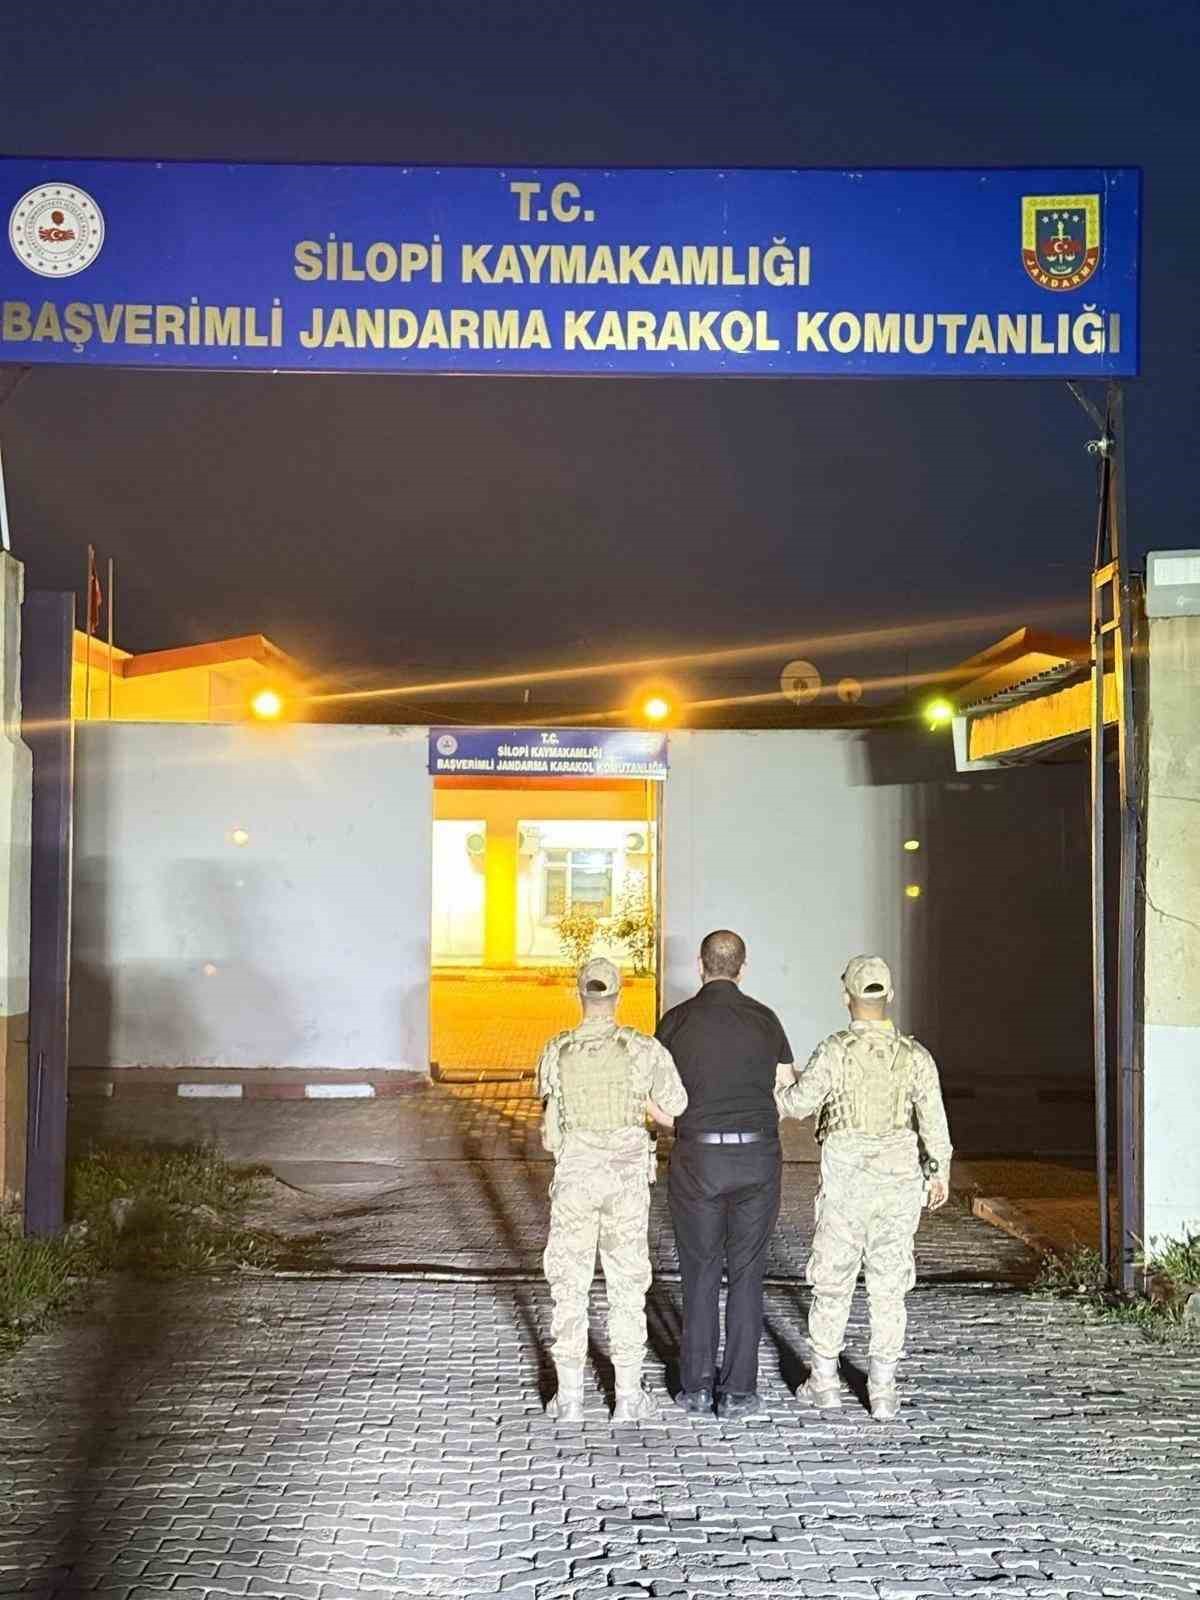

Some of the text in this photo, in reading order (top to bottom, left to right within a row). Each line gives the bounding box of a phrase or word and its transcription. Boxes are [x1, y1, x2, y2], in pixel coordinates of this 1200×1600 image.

[510, 182, 595, 222] T.C.
[294, 233, 811, 287] SİLOPİ KAYMAKAMLIĞI
[1026, 257, 1096, 288] JANDARMA
[2, 296, 1121, 355] BAŞVERİMLİ JANDARMA KARAKOL KOMUTANLIĞI
[497, 744, 602, 759] SİLOPİ KAYMAKAMLIĞI
[541, 733, 559, 745] T.C.
[437, 758, 494, 771] BAŞVERİMLİ
[497, 760, 548, 771] JANDARMA
[550, 761, 594, 773] KARAKOL
